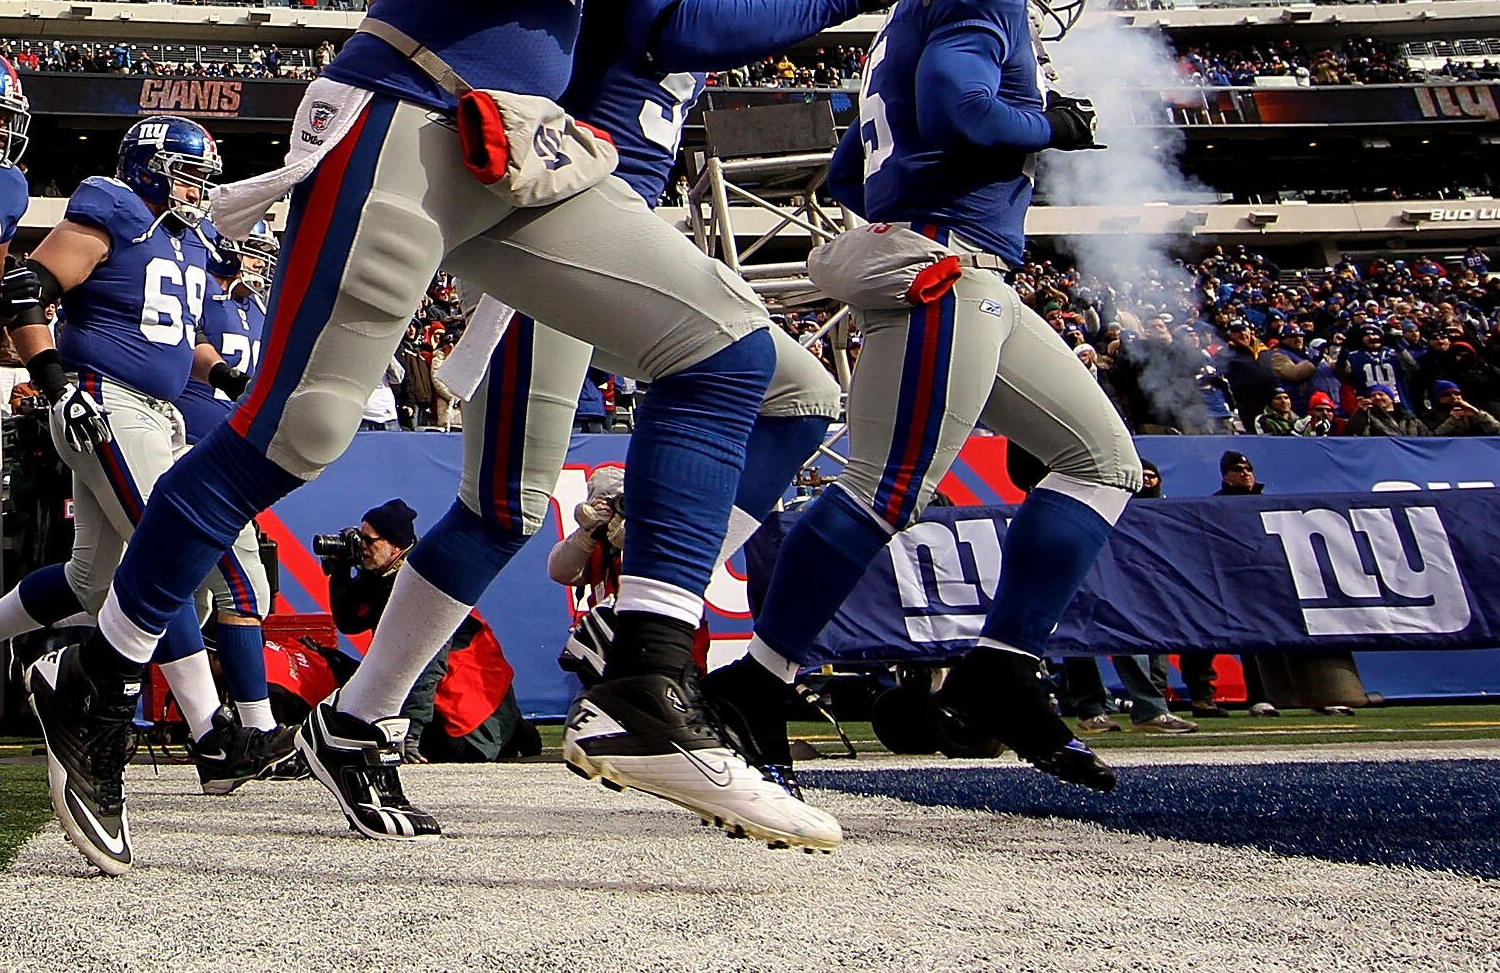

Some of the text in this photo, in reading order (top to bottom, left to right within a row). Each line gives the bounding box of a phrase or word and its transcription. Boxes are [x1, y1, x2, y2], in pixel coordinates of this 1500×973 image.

[140, 78, 243, 112] GIANTS
[138, 123, 170, 145] ny
[1430, 208, 1475, 221] BUD
[139, 256, 207, 351] 69
[1362, 362, 1398, 391] 10
[1259, 505, 1473, 637] ny
